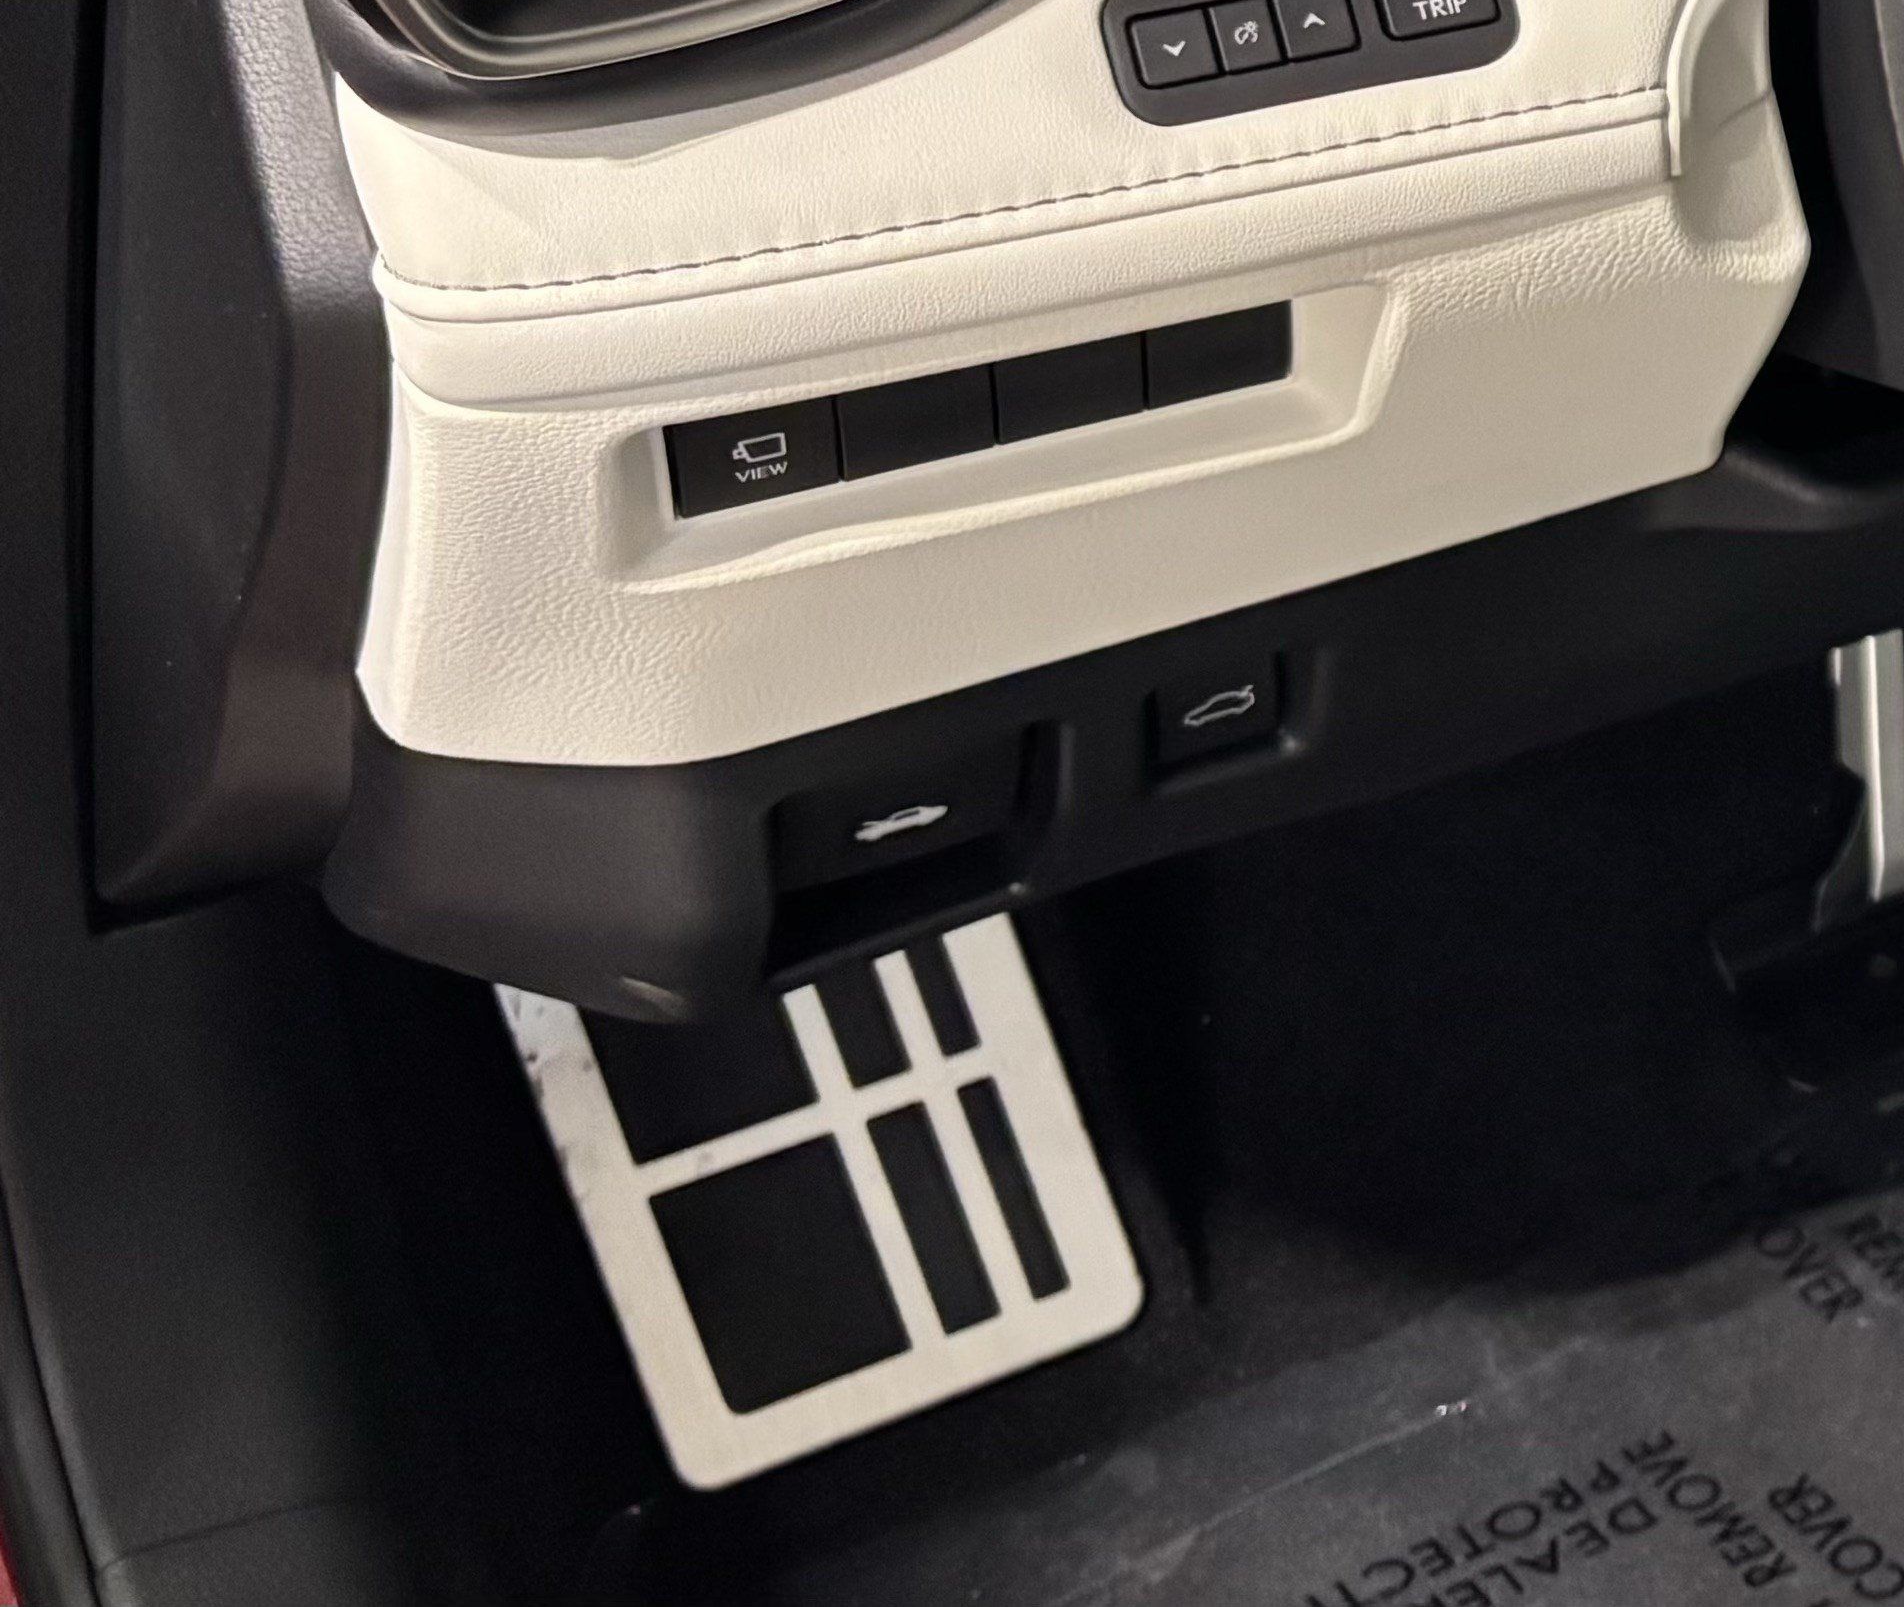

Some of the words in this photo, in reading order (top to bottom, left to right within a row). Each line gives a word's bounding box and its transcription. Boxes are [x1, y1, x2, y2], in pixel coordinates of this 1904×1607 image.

[735, 461, 788, 482] VIEW
[1755, 1222, 1863, 1322] OVER
[1621, 1429, 1797, 1590] REMOVE
